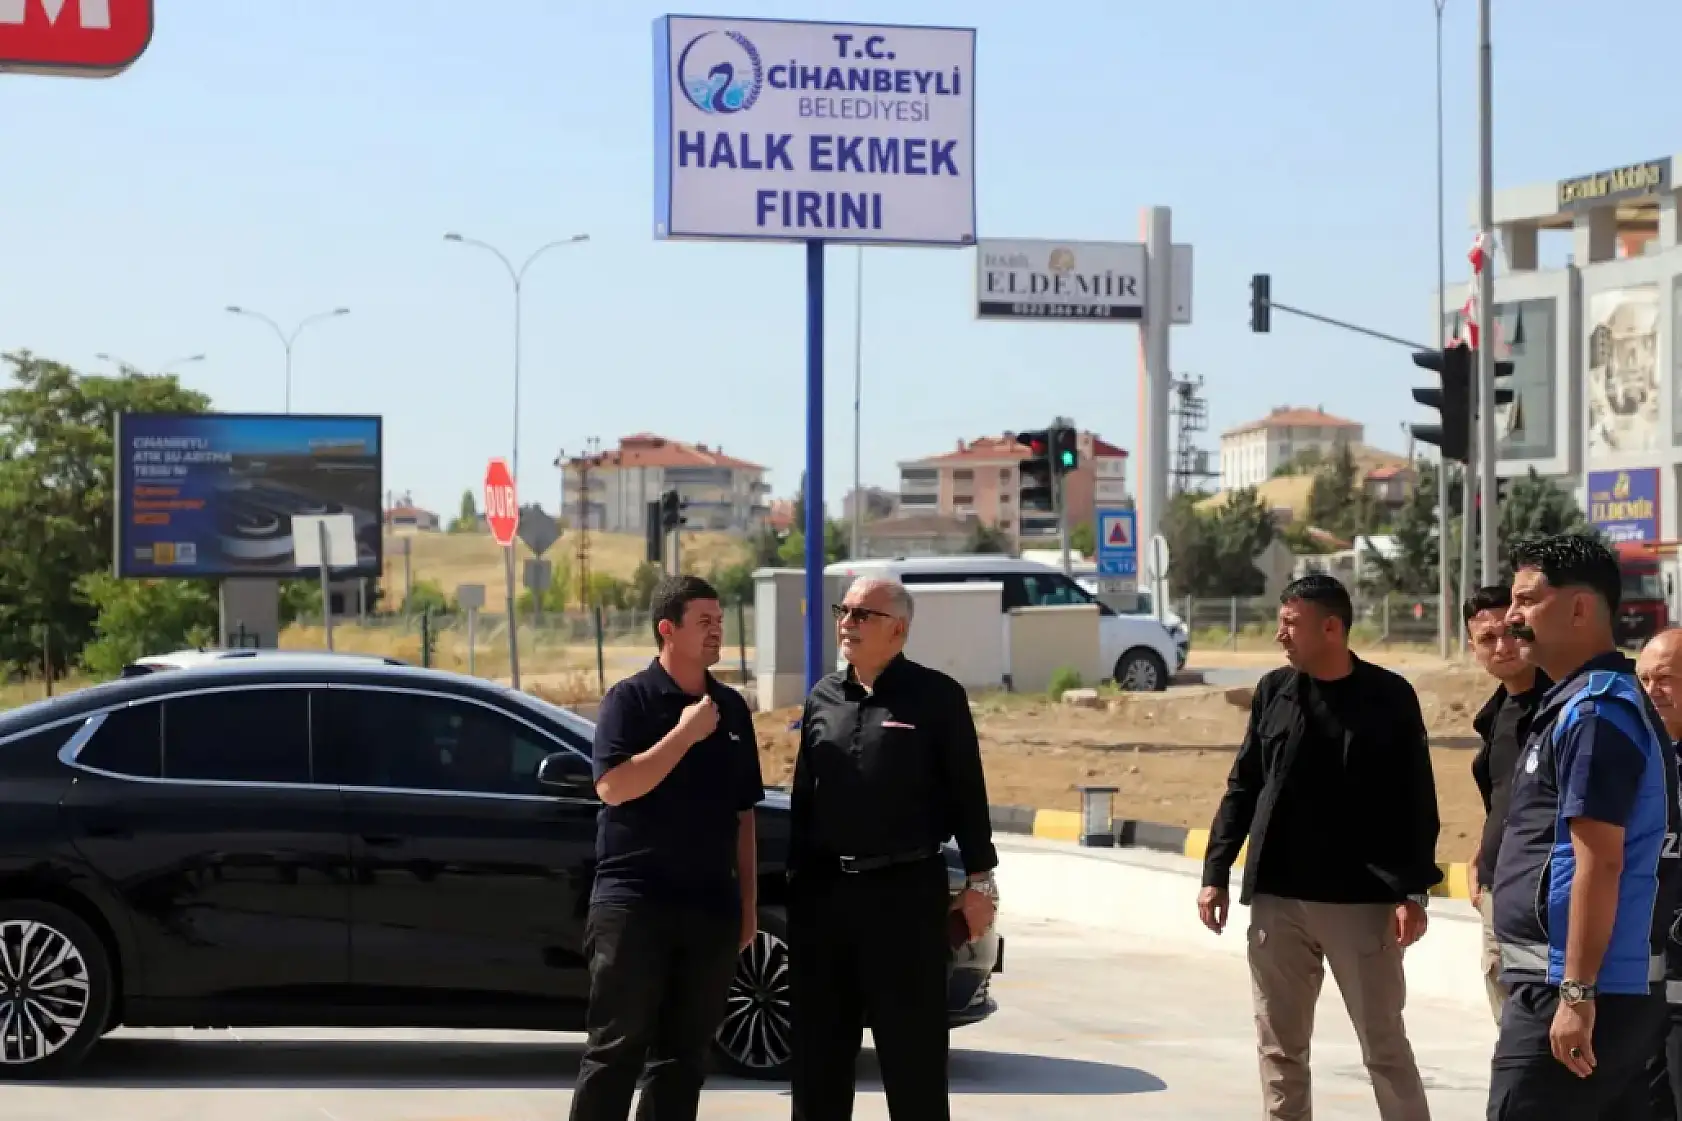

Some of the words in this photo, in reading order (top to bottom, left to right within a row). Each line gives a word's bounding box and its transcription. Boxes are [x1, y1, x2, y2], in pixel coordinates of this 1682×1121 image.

[832, 34, 896, 60] T.C.
[767, 59, 961, 96] CİHANBEYLİ
[798, 95, 930, 122] BELEDİYESİ
[678, 130, 795, 171] HALK
[809, 134, 959, 176] EKMEK
[756, 189, 882, 229] FIRINI
[986, 269, 1141, 298] ELDEMİR
[486, 485, 515, 519] DUR
